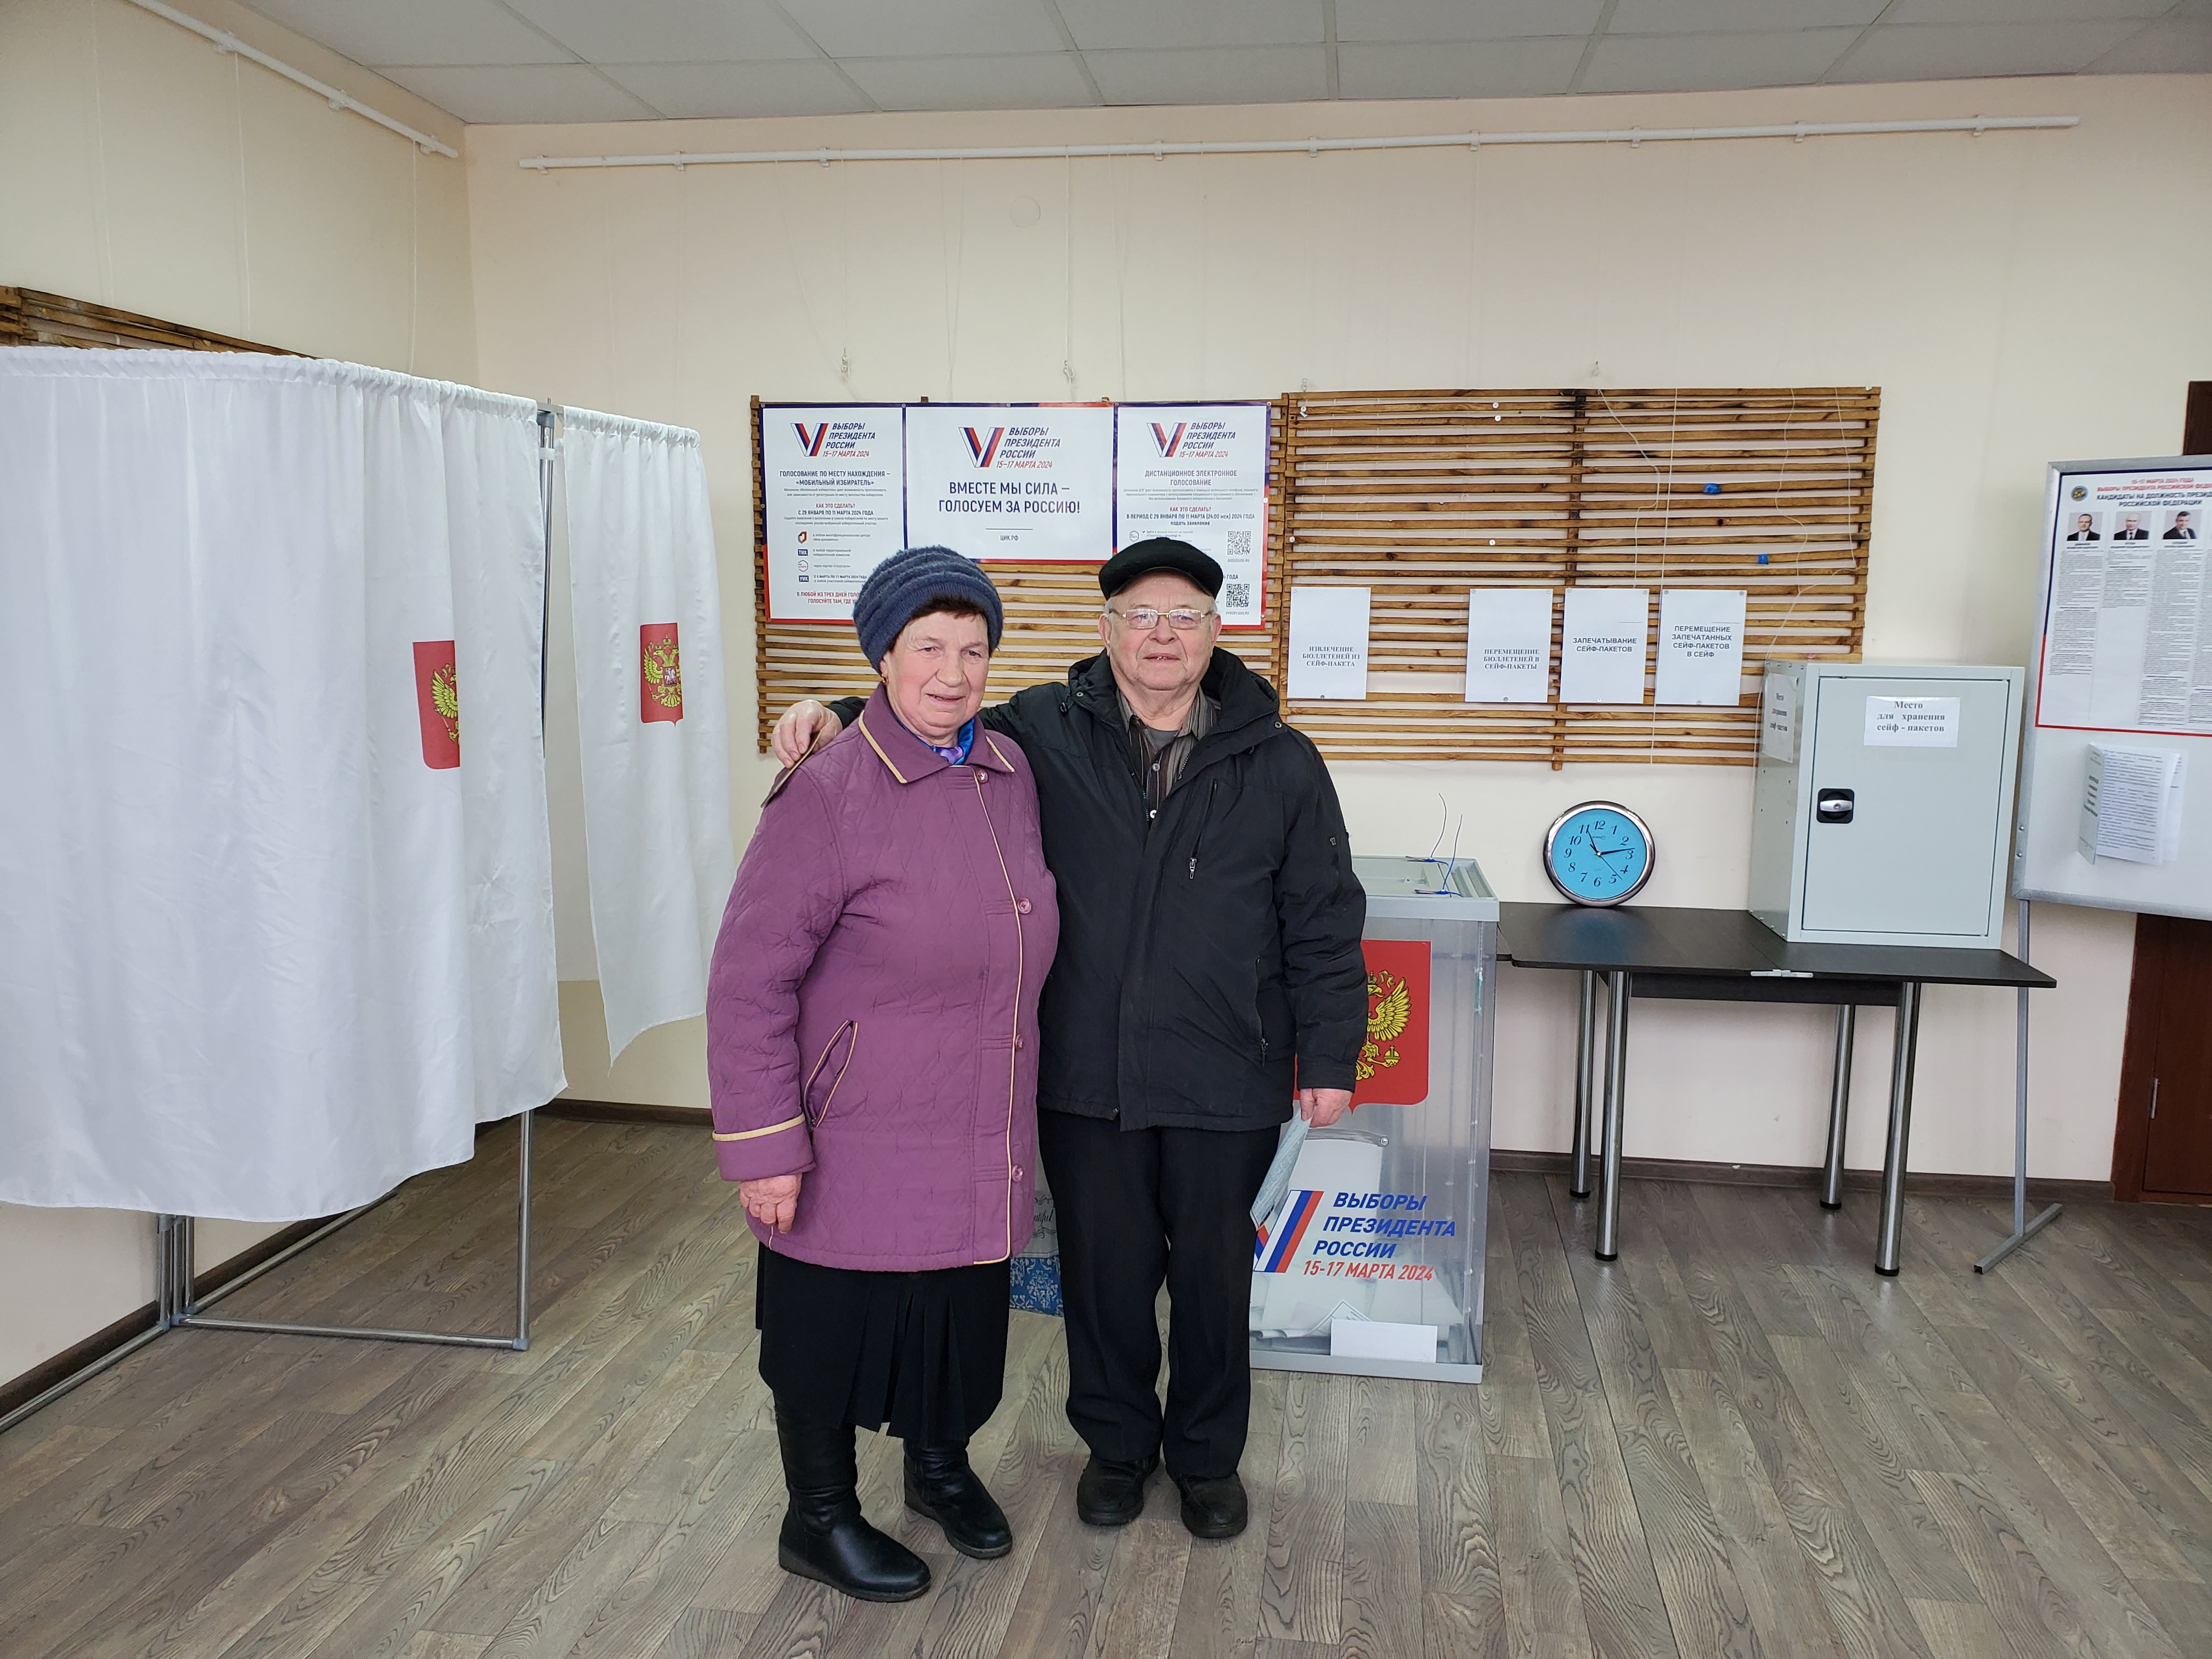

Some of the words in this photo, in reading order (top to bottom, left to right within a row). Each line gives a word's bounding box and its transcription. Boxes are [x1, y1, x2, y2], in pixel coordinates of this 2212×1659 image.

[1009, 427, 1049, 436] ВЫБОРЫ
[1186, 432, 1236, 441] ПРЕЗИДЕНТА
[1004, 439, 1061, 448] ПРЕЗИДЕНТА
[1000, 450, 1036, 458] РОССИИ
[950, 482, 996, 494] ВМЕСТЕ
[1000, 482, 1021, 494] МЫ
[1025, 482, 1058, 495] СИЛА
[939, 500, 1002, 513] ГОЛОСУЕМ
[1006, 500, 1020, 513] ЗА
[1024, 500, 1080, 514] РОССИЮ!
[1673, 641, 1730, 650] СЕЙФ-ПАКЕТОВ
[1694, 650, 1714, 658] СЕЙФ
[1877, 713, 1894, 721] для
[1901, 713, 1945, 723] хранения
[1877, 723, 1899, 733] сейф
[1578, 824, 1590, 834] 11
[1593, 820, 1606, 830] 12
[1611, 825, 1617, 835] 1
[1570, 836, 1582, 845] 10
[1620, 836, 1629, 846] 2
[1564, 848, 1572, 858] 9
[1626, 850, 1634, 860] 3
[1568, 862, 1576, 872] 8
[1620, 865, 1629, 874] 4
[1581, 872, 1588, 882] 7
[1594, 877, 1601, 887] 6
[1609, 874, 1617, 884] 5
[1333, 1192, 1427, 1210] ВЫБОРЫ
[1323, 1216, 1455, 1238] ПРЕЗИДЕНТА
[1313, 1240, 1397, 1259] РОССИИ
[1303, 1260, 1345, 1276] 15-17
[1345, 1263, 1396, 1279] МАРТА
[1398, 1265, 1435, 1281] 2024
